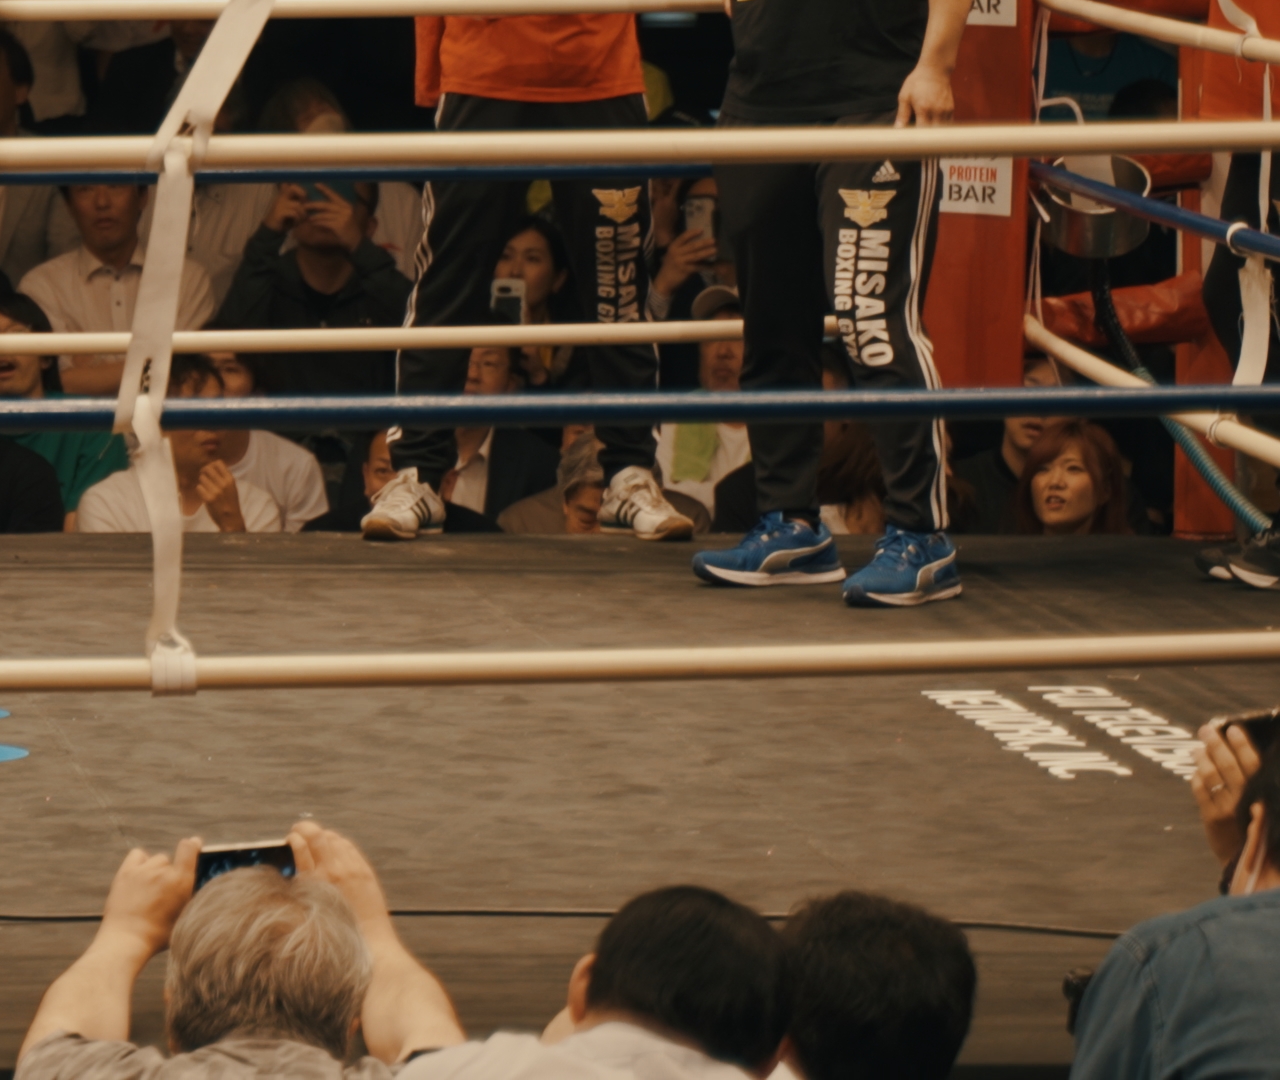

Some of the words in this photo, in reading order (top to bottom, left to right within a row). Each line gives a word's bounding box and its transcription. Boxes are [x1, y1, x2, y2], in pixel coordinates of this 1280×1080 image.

[948, 184, 997, 204] BAR
[949, 165, 998, 183] PROTEIN
[595, 226, 616, 298] BOXING
[616, 222, 640, 322] MISAK
[834, 228, 858, 311] BOXING
[854, 229, 894, 367] MISAKO
